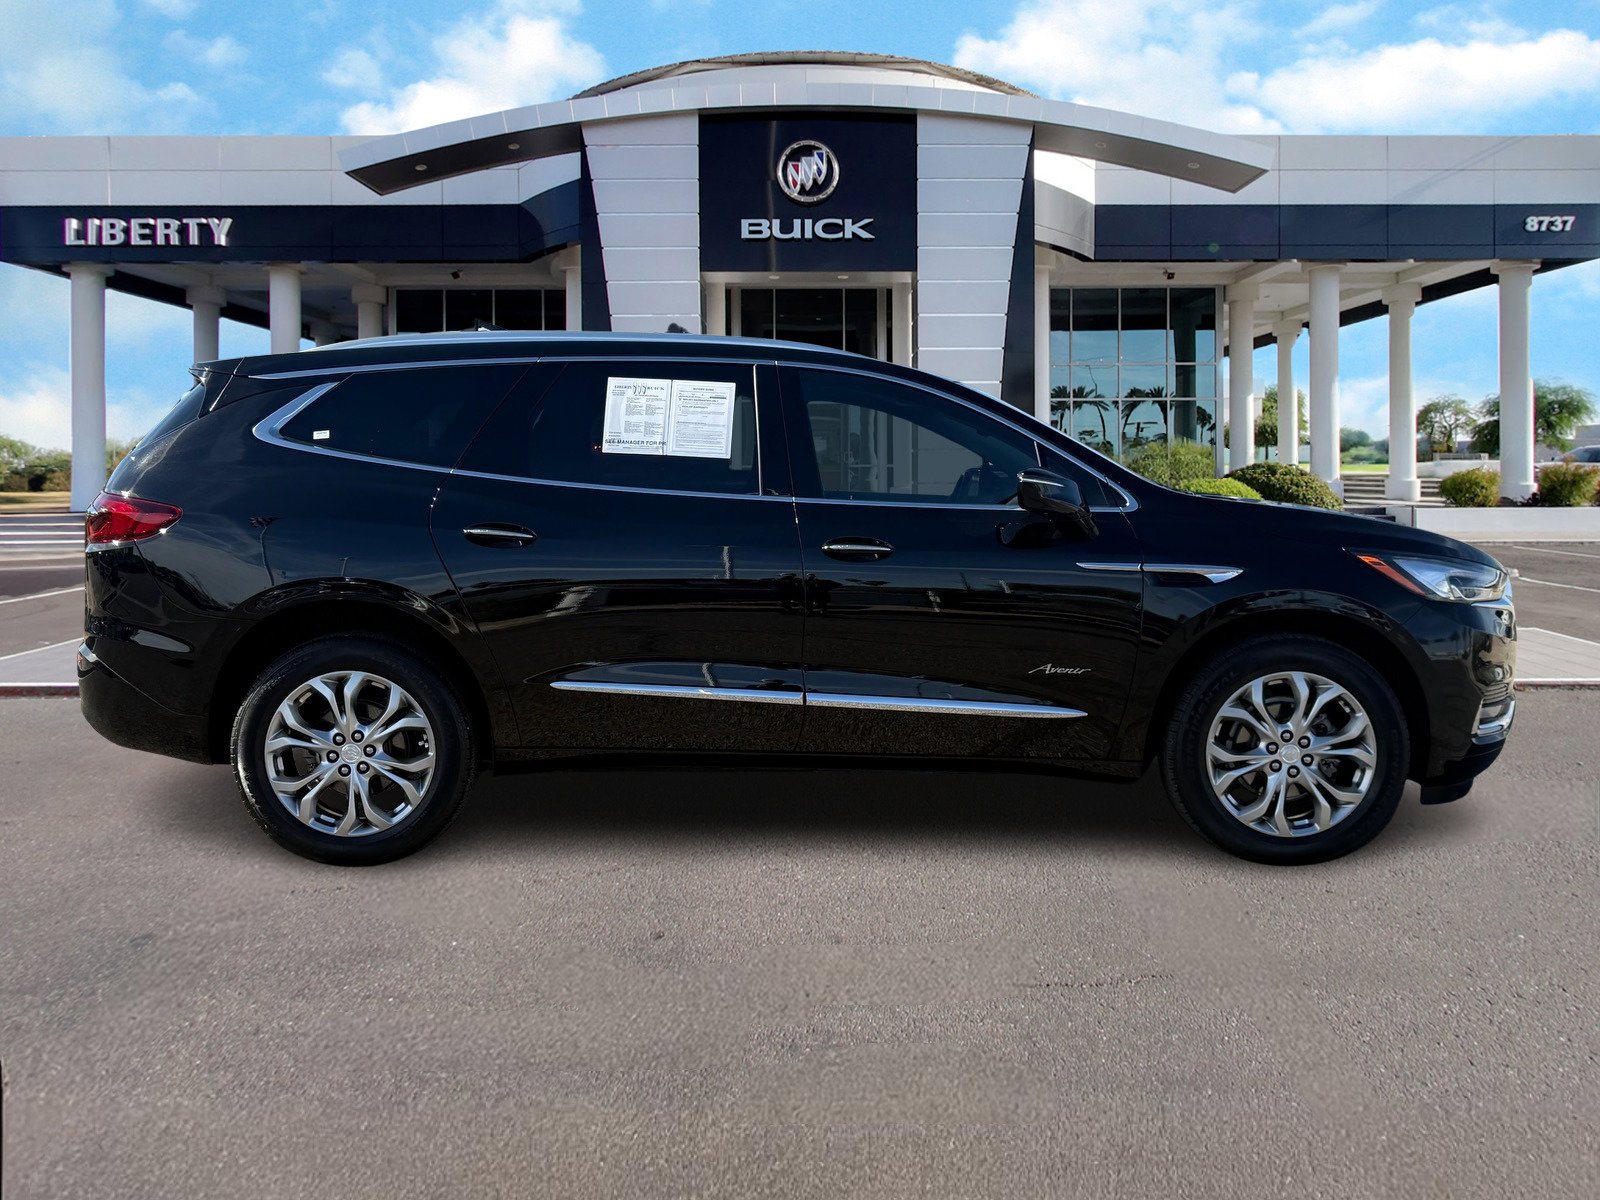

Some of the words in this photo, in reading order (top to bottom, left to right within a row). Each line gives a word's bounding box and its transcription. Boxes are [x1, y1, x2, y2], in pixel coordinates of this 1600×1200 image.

[64, 217, 233, 247] LIBERTY
[740, 218, 876, 240] BUICK
[1524, 215, 1576, 232] 8737
[1028, 663, 1091, 674] Avenir
